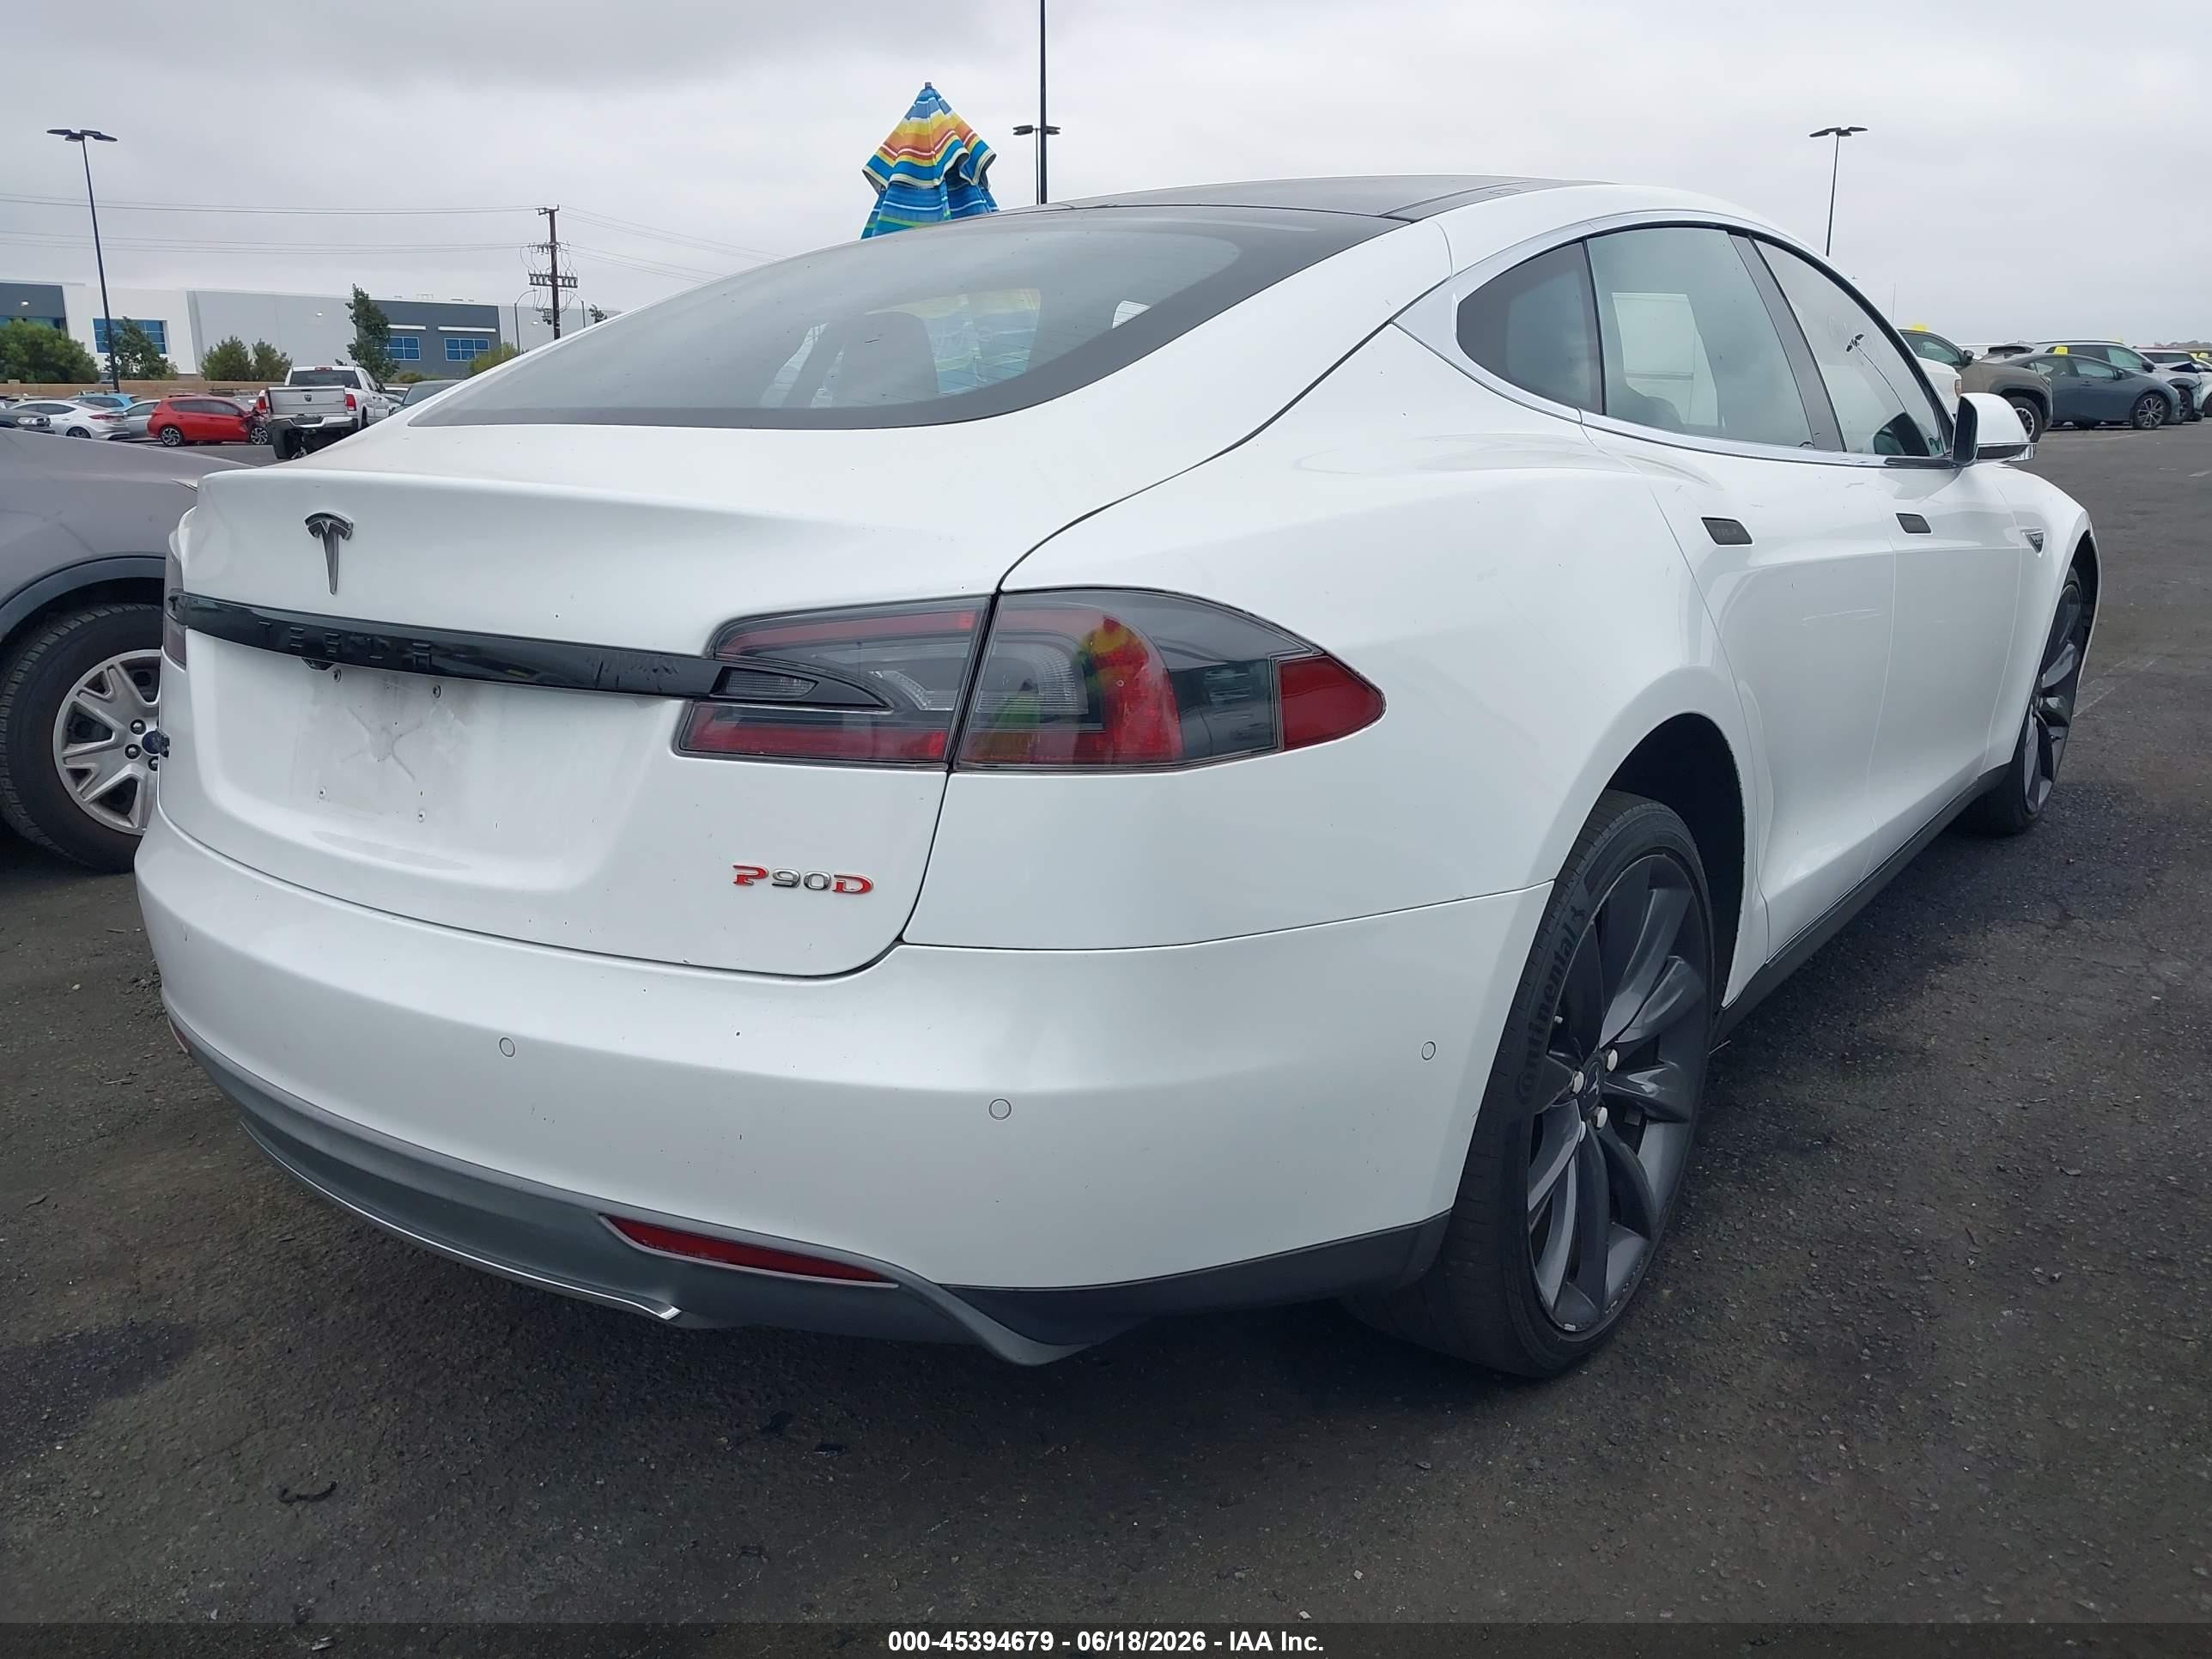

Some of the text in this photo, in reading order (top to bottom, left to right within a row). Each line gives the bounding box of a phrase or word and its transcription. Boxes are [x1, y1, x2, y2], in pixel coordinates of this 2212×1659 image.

[258, 620, 434, 668] TESLA
[732, 864, 874, 895] P90D
[1516, 921, 1578, 1106] Continental
